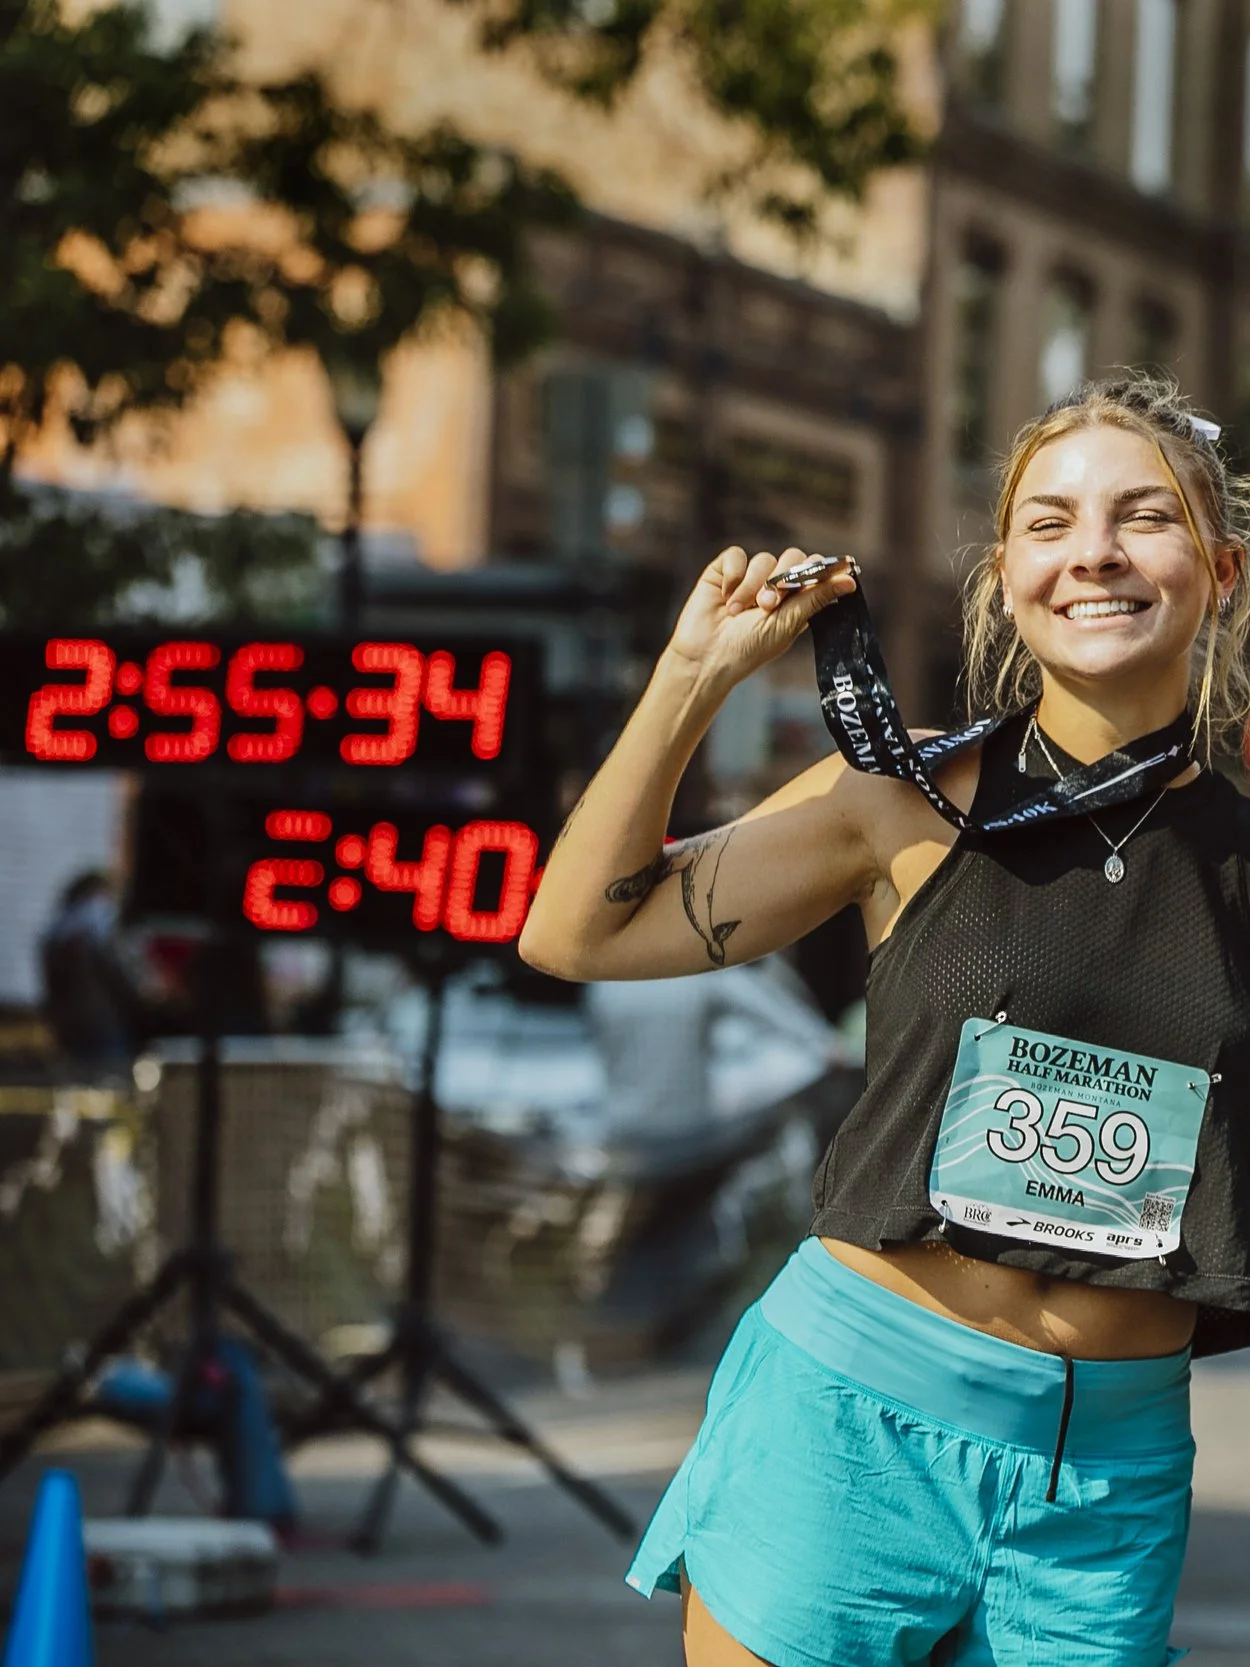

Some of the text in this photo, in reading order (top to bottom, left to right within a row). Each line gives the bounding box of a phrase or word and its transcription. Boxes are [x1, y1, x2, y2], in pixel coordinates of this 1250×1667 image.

[832, 674, 881, 773] BOZEM
[1009, 1036, 1159, 1087] BOZEMAN
[1007, 1059, 1152, 1101] HALF MARATHON
[1031, 1082, 1121, 1107] BOZEMAN MONTANA
[986, 1087, 1151, 1185] 359
[1025, 1180, 1085, 1207] EMMA
[1033, 1221, 1095, 1242] BROOKS
[1106, 1232, 1143, 1247] aprs
